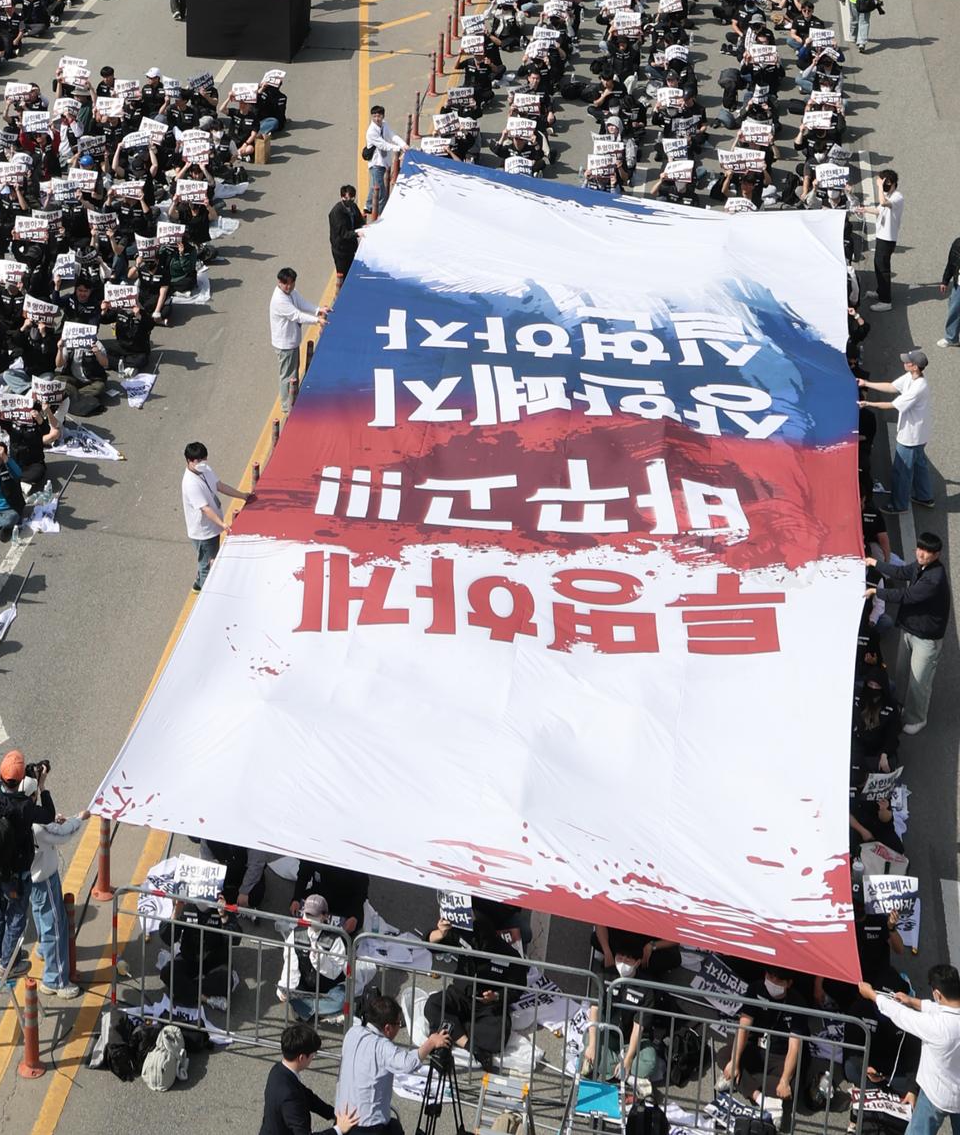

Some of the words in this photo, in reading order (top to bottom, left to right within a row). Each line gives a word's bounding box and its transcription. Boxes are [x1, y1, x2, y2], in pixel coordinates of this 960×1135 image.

[18, 221, 45, 230] 투명하게
[107, 287, 135, 297] 투명하게
[27, 300, 55, 313] 투명하게
[65, 326, 95, 336] 상한폐지
[376, 306, 761, 366] 실현하자
[66, 337, 94, 347] 실현하자
[1, 397, 31, 408] 투명하게
[367, 364, 788, 440] 상한폐지
[3, 410, 34, 421] 바꾸고!!!
[315, 458, 751, 537] 바꾸고!!!
[292, 549, 786, 655] 투명하게
[179, 865, 221, 880] 상한폐지
[868, 878, 913, 894] 상한폐지
[440, 894, 465, 907] 한폐지
[872, 898, 914, 914] 실현하자
[441, 911, 473, 924] 현하자
